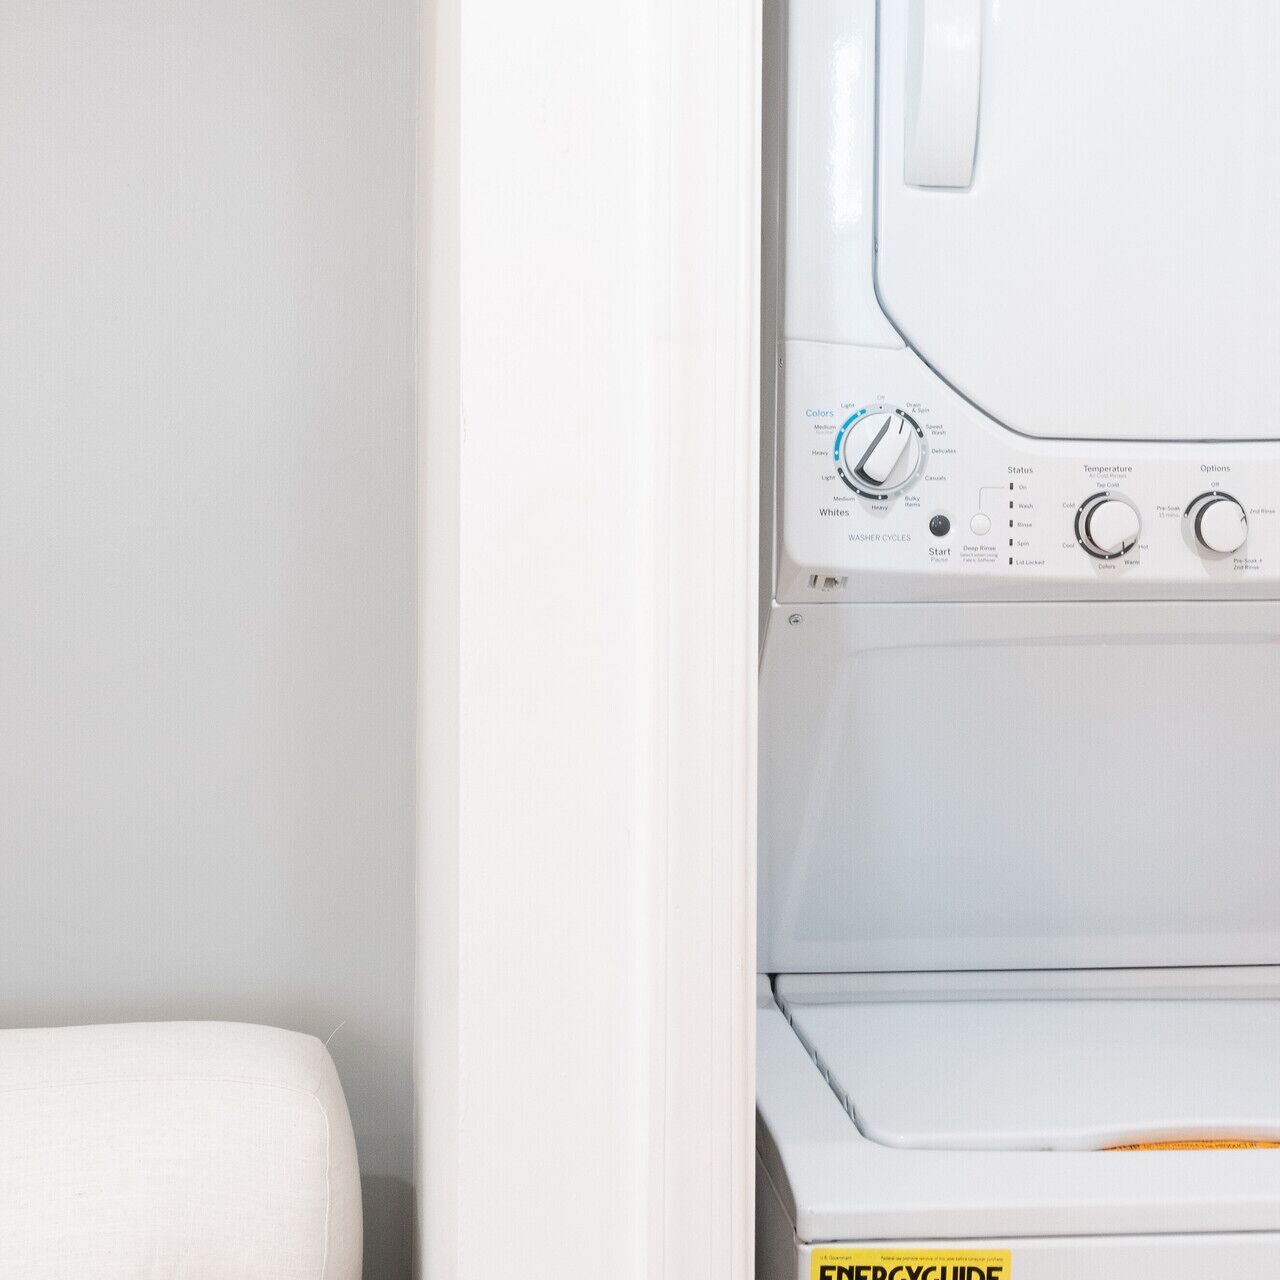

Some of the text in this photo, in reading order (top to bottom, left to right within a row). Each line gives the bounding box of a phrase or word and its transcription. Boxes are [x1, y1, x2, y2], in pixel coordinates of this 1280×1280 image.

[805, 409, 834, 418] Colors
[1007, 466, 1034, 474] Status
[1083, 465, 1133, 474] Temperature
[1200, 464, 1231, 473] Options
[819, 508, 850, 517] Whites
[848, 534, 911, 542] WASHER CYCLES
[928, 547, 951, 557] Start
